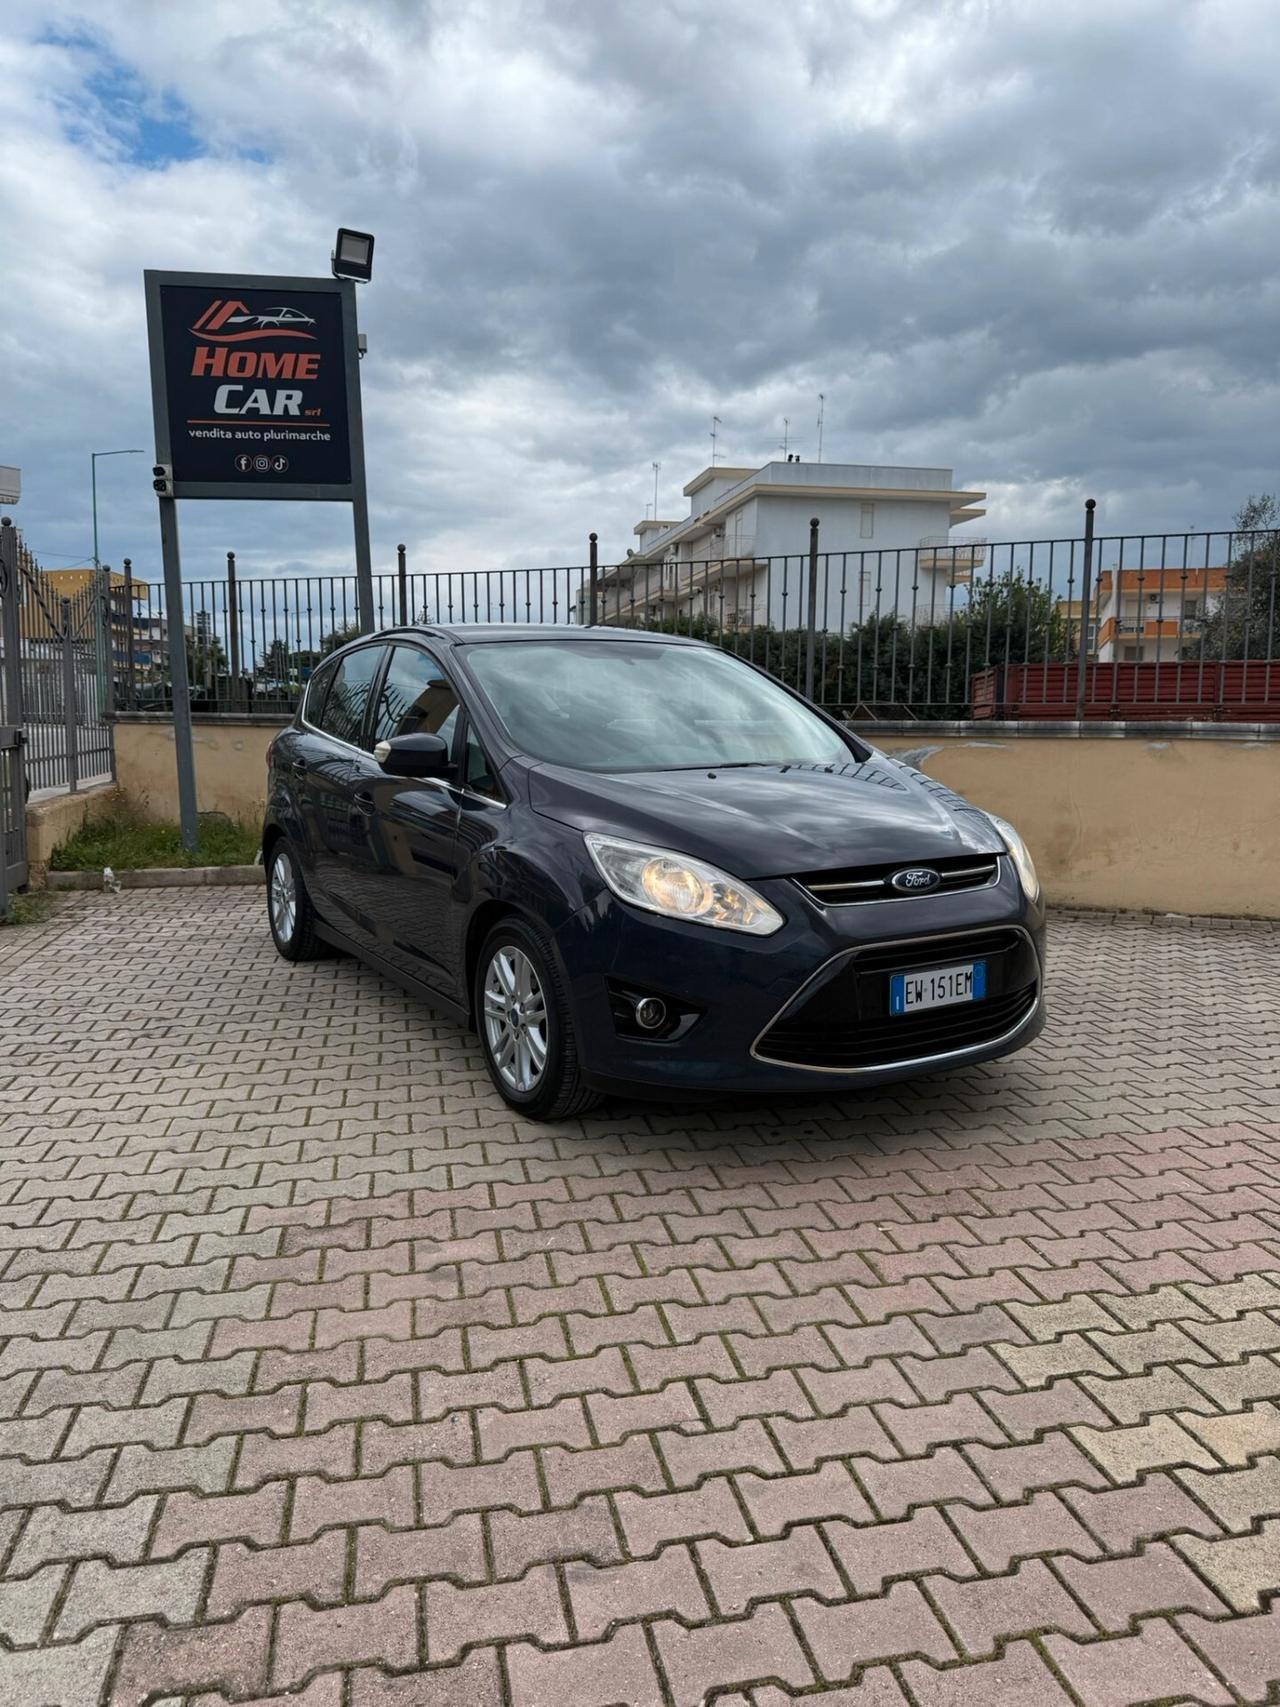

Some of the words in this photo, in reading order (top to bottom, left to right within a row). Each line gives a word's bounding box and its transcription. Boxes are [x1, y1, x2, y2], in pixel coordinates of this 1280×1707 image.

[191, 346, 321, 380] HOME
[213, 384, 303, 416] CAR
[304, 408, 321, 416] srl
[188, 428, 232, 439] vendita
[235, 430, 262, 439] auto
[263, 428, 331, 442] plurimarche
[905, 871, 931, 887] Ford
